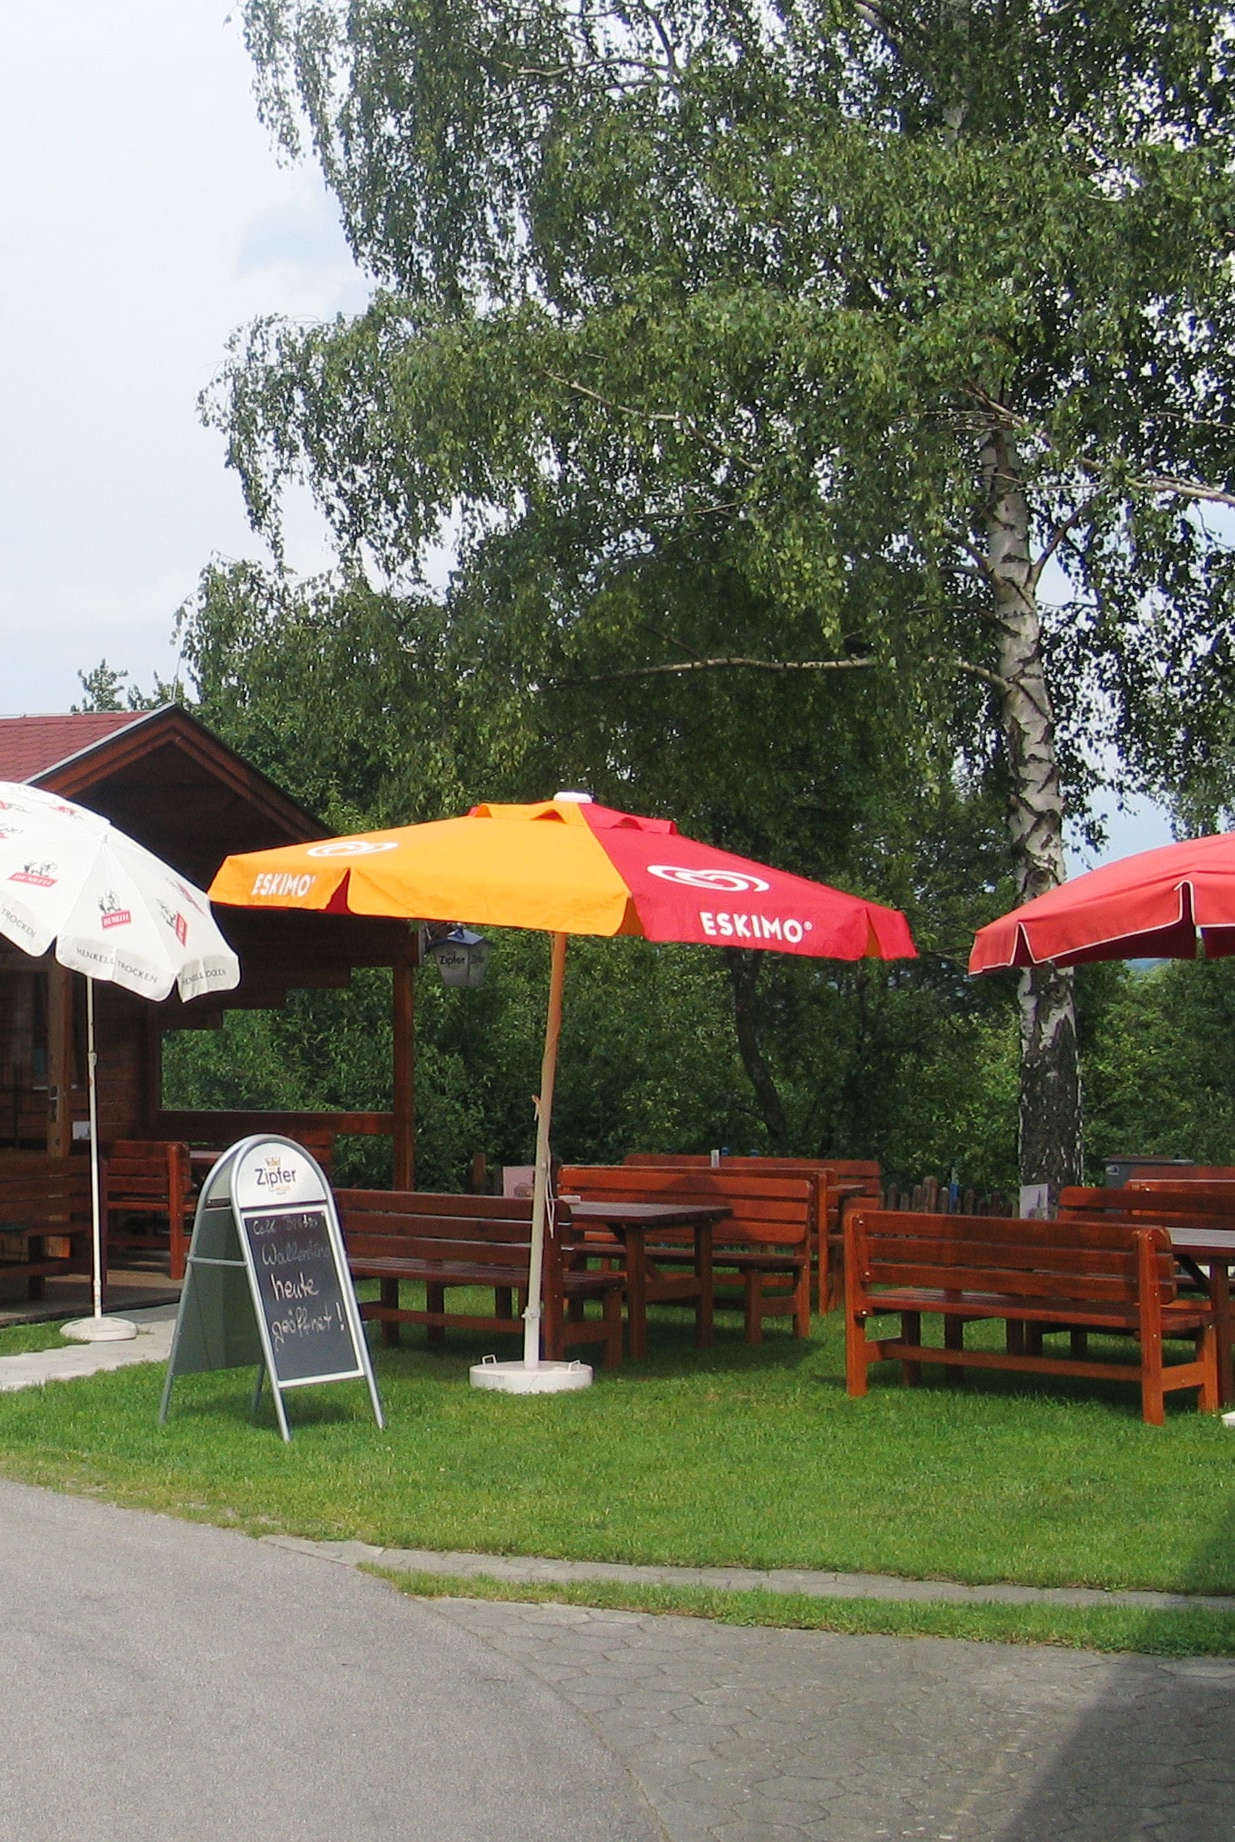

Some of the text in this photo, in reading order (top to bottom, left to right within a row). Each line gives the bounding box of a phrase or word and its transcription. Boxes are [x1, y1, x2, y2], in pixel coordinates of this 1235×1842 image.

[1, 907, 37, 938] TROCKEN
[76, 946, 159, 984] HENKELL TROCKEN
[254, 1166, 297, 1189] Zipfer
[270, 1271, 320, 1302] heute
